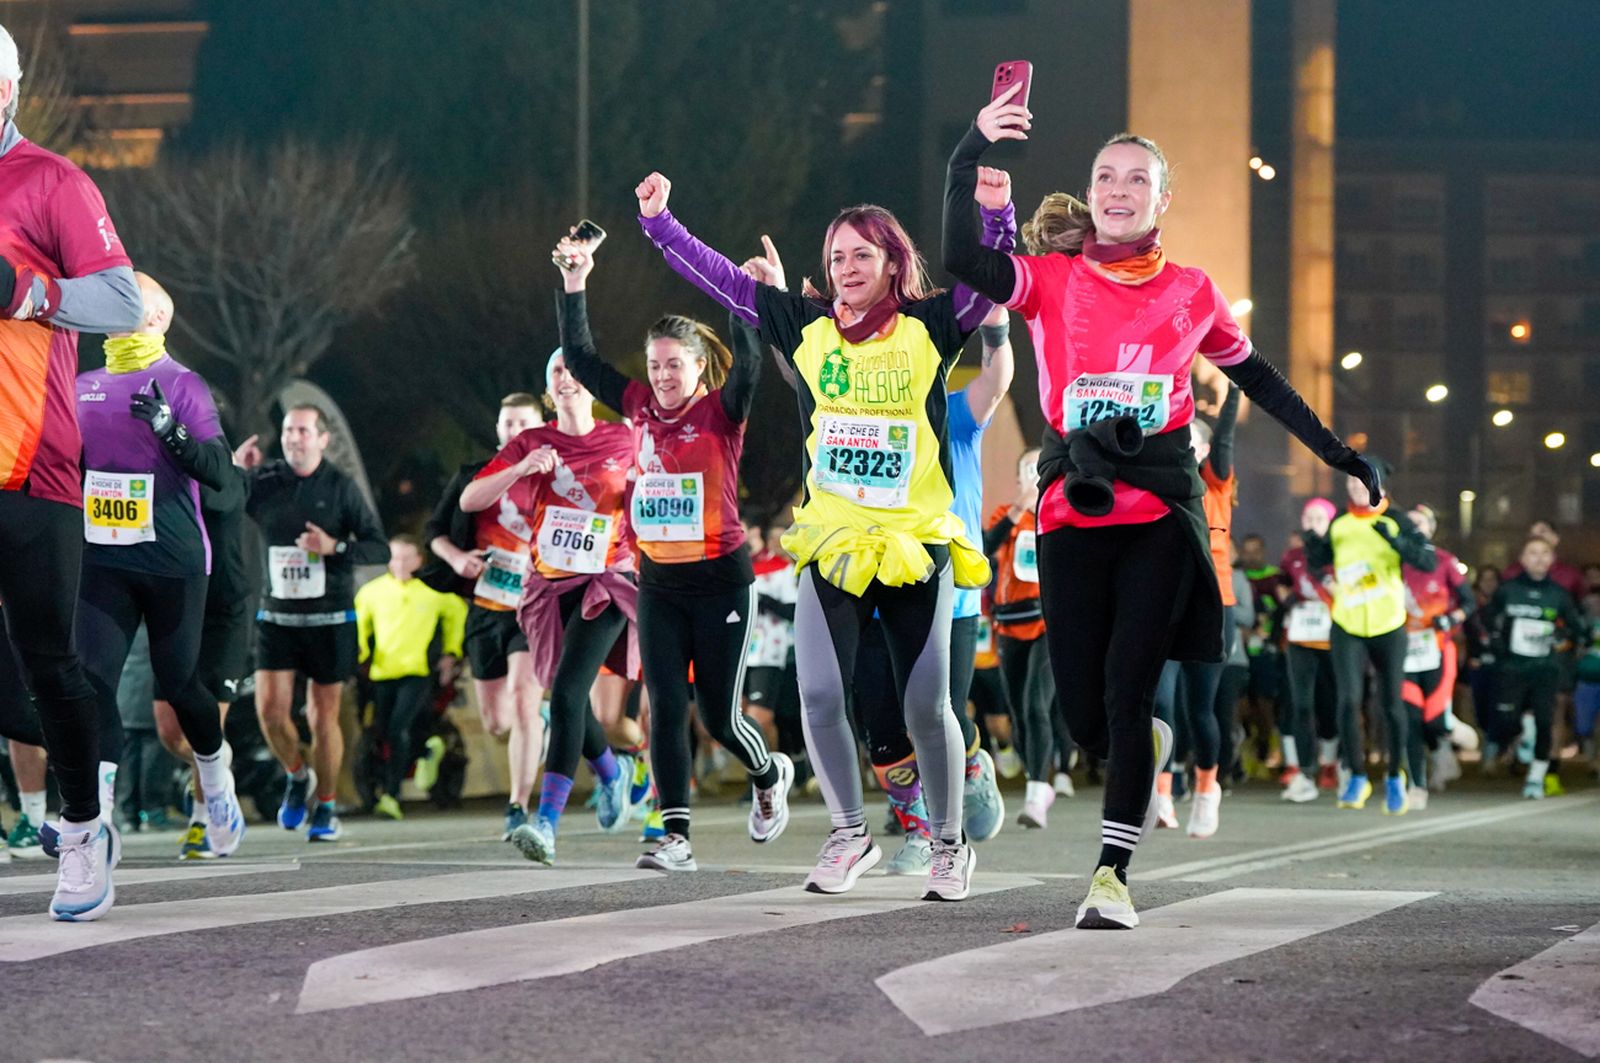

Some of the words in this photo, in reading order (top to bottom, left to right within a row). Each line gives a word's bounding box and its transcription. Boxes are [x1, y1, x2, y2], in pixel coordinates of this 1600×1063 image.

[855, 370, 913, 403] ALBOR
[1089, 380, 1120, 389] NOCHE
[1122, 383, 1135, 393] DE
[1076, 388, 1097, 399] SAN
[860, 408, 913, 417] PROFESIONAL
[868, 428, 880, 437] DE
[826, 436, 845, 446] SAN
[826, 447, 902, 479] 12323
[114, 481, 122, 489] DE
[645, 481, 665, 489] NOCHE
[667, 481, 675, 489] DE
[567, 487, 584, 501] 43
[93, 497, 138, 521] 3406
[639, 497, 694, 518] 13090
[551, 528, 595, 552] 6766
[282, 567, 310, 579] 4114
